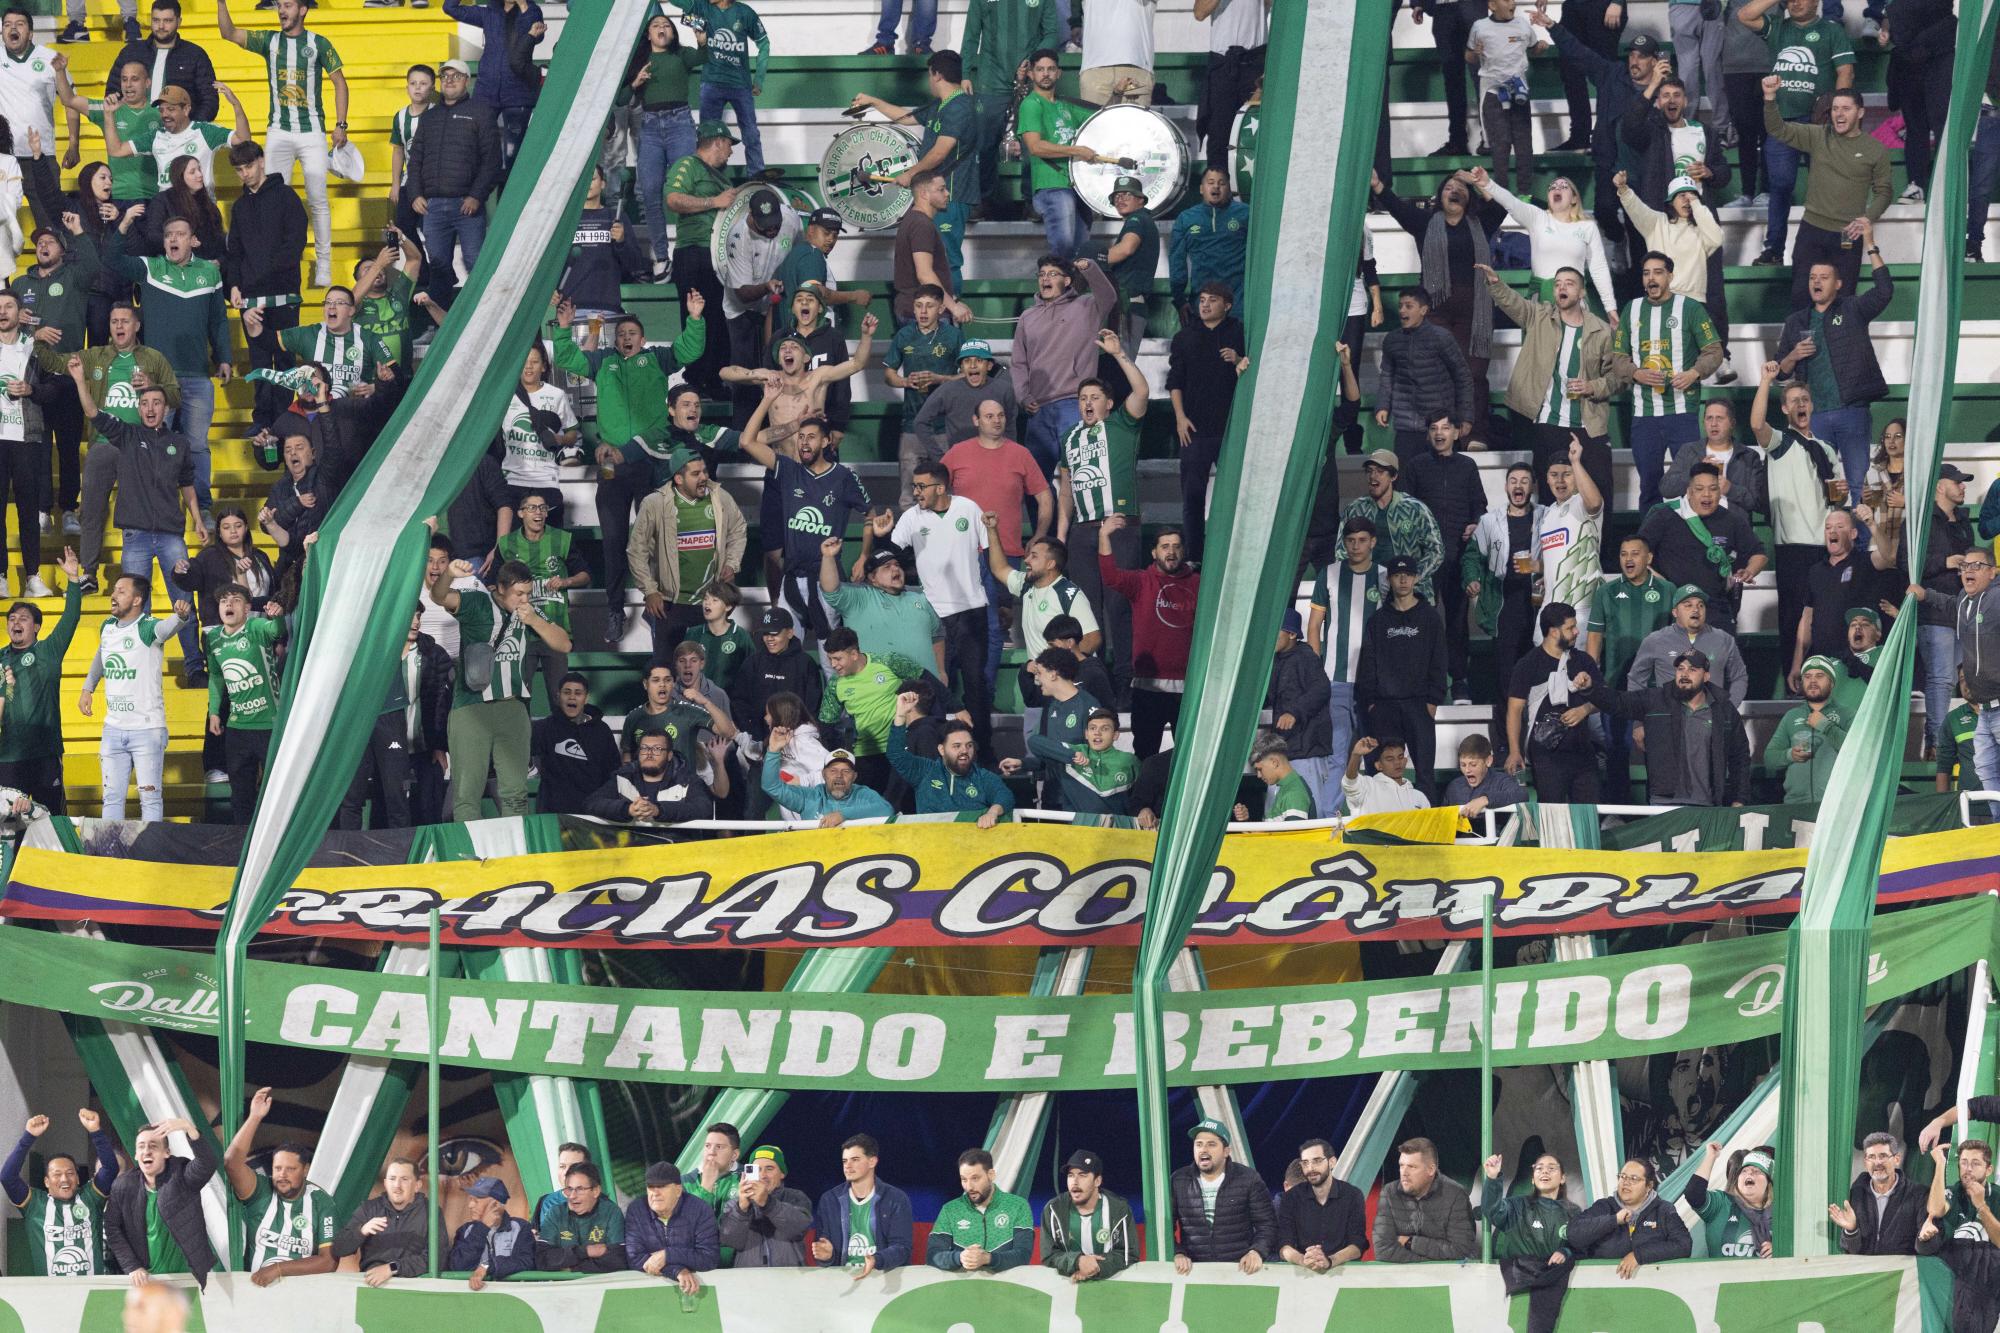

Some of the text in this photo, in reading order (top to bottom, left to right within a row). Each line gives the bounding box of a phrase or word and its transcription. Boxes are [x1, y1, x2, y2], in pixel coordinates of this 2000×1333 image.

[1772, 61, 1819, 75] Aurora
[1780, 79, 1815, 90] SICOOB
[827, 131, 904, 175] BARRA DA CHAPE
[836, 189, 911, 223] ETERNOS CAMPEO
[720, 200, 743, 244] ROUPEIRO
[718, 246, 725, 262] DO
[335, 364, 360, 372] zero
[508, 429, 541, 444] Auro
[1081, 439, 1105, 452] zero
[1081, 446, 1107, 461] um
[788, 517, 832, 536] aurora
[235, 696, 267, 712] SICOOB
[188, 855, 916, 940] RACIAS
[142, 968, 219, 987] PURO MALT
[88, 981, 251, 1024] Dall
[140, 1016, 198, 1029] Chopp
[279, 983, 946, 1081] CANTANDO
[984, 1014, 1070, 1080] E
[1103, 963, 1694, 1076] BEBENDO
[281, 1242, 311, 1256] um
[282, 1236, 309, 1247] zero
[52, 1261, 90, 1275] Aurora
